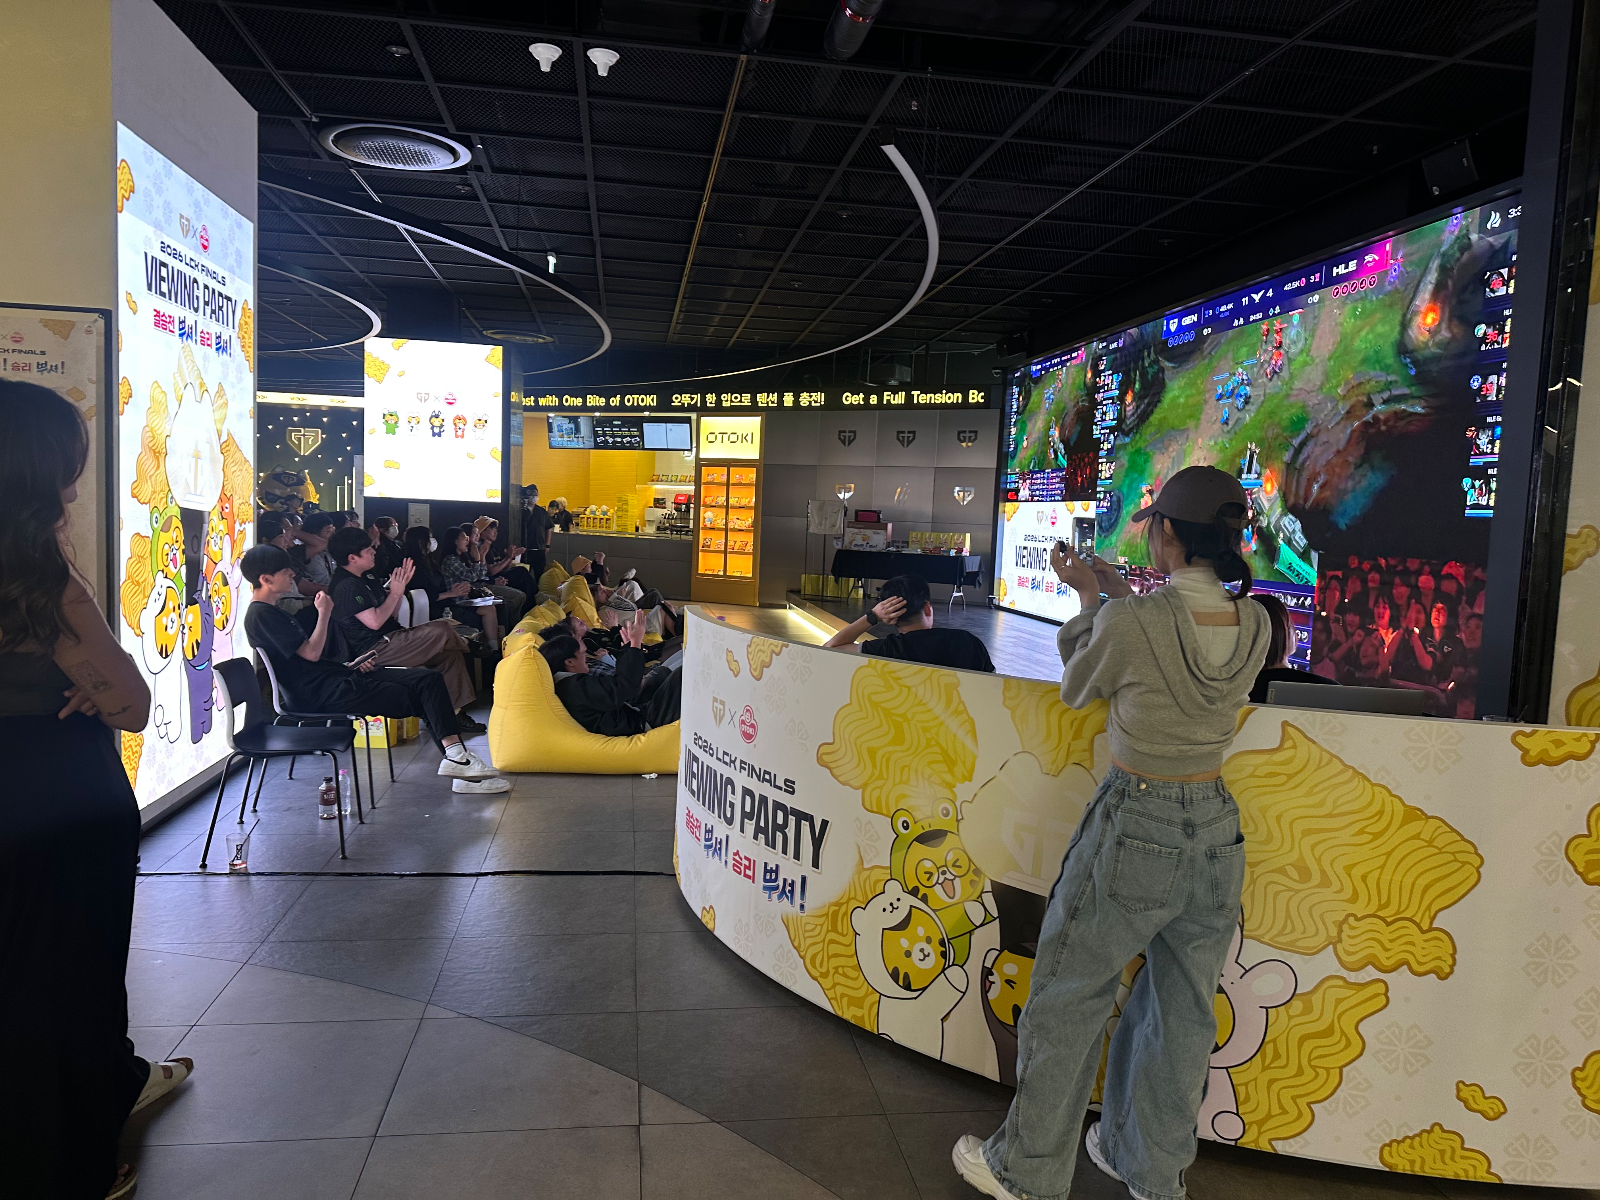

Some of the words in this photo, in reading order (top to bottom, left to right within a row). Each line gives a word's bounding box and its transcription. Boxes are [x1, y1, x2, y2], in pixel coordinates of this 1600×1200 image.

[160, 240, 184, 263] 2026
[184, 253, 200, 273] LCK
[200, 263, 226, 287] FINALS
[1332, 259, 1358, 277] HLE
[144, 250, 200, 314] VIEWING
[203, 282, 238, 330] PARTY
[1181, 313, 1198, 326] GEN
[1241, 296, 1249, 307] 11
[1266, 288, 1274, 298] 4
[153, 308, 176, 334] 결승전
[199, 328, 213, 349] 승리
[11, 348, 47, 356] FINALS
[11, 362, 32, 372] 승리
[537, 394, 559, 406] with
[562, 394, 583, 406] One
[586, 394, 606, 406] Bite
[609, 394, 621, 406] of
[624, 394, 657, 407] OTOKI
[671, 393, 700, 408] 오뚜기
[705, 393, 716, 407] 한
[721, 393, 752, 407] 입으로
[757, 392, 778, 407] 텐션
[783, 392, 795, 407] 풀
[799, 391, 825, 407] 충전!
[842, 391, 865, 405] Get
[869, 395, 878, 404] a
[883, 391, 905, 405] Full
[911, 389, 962, 404] Tension
[705, 431, 755, 445] OTOKI
[1015, 545, 1048, 572] VIEWING
[693, 731, 715, 758] 2026
[715, 746, 739, 771] LCK
[739, 760, 796, 796] FINALS
[684, 743, 736, 827] VIEWING
[739, 785, 830, 871] PARTY
[732, 849, 757, 885] 승리
